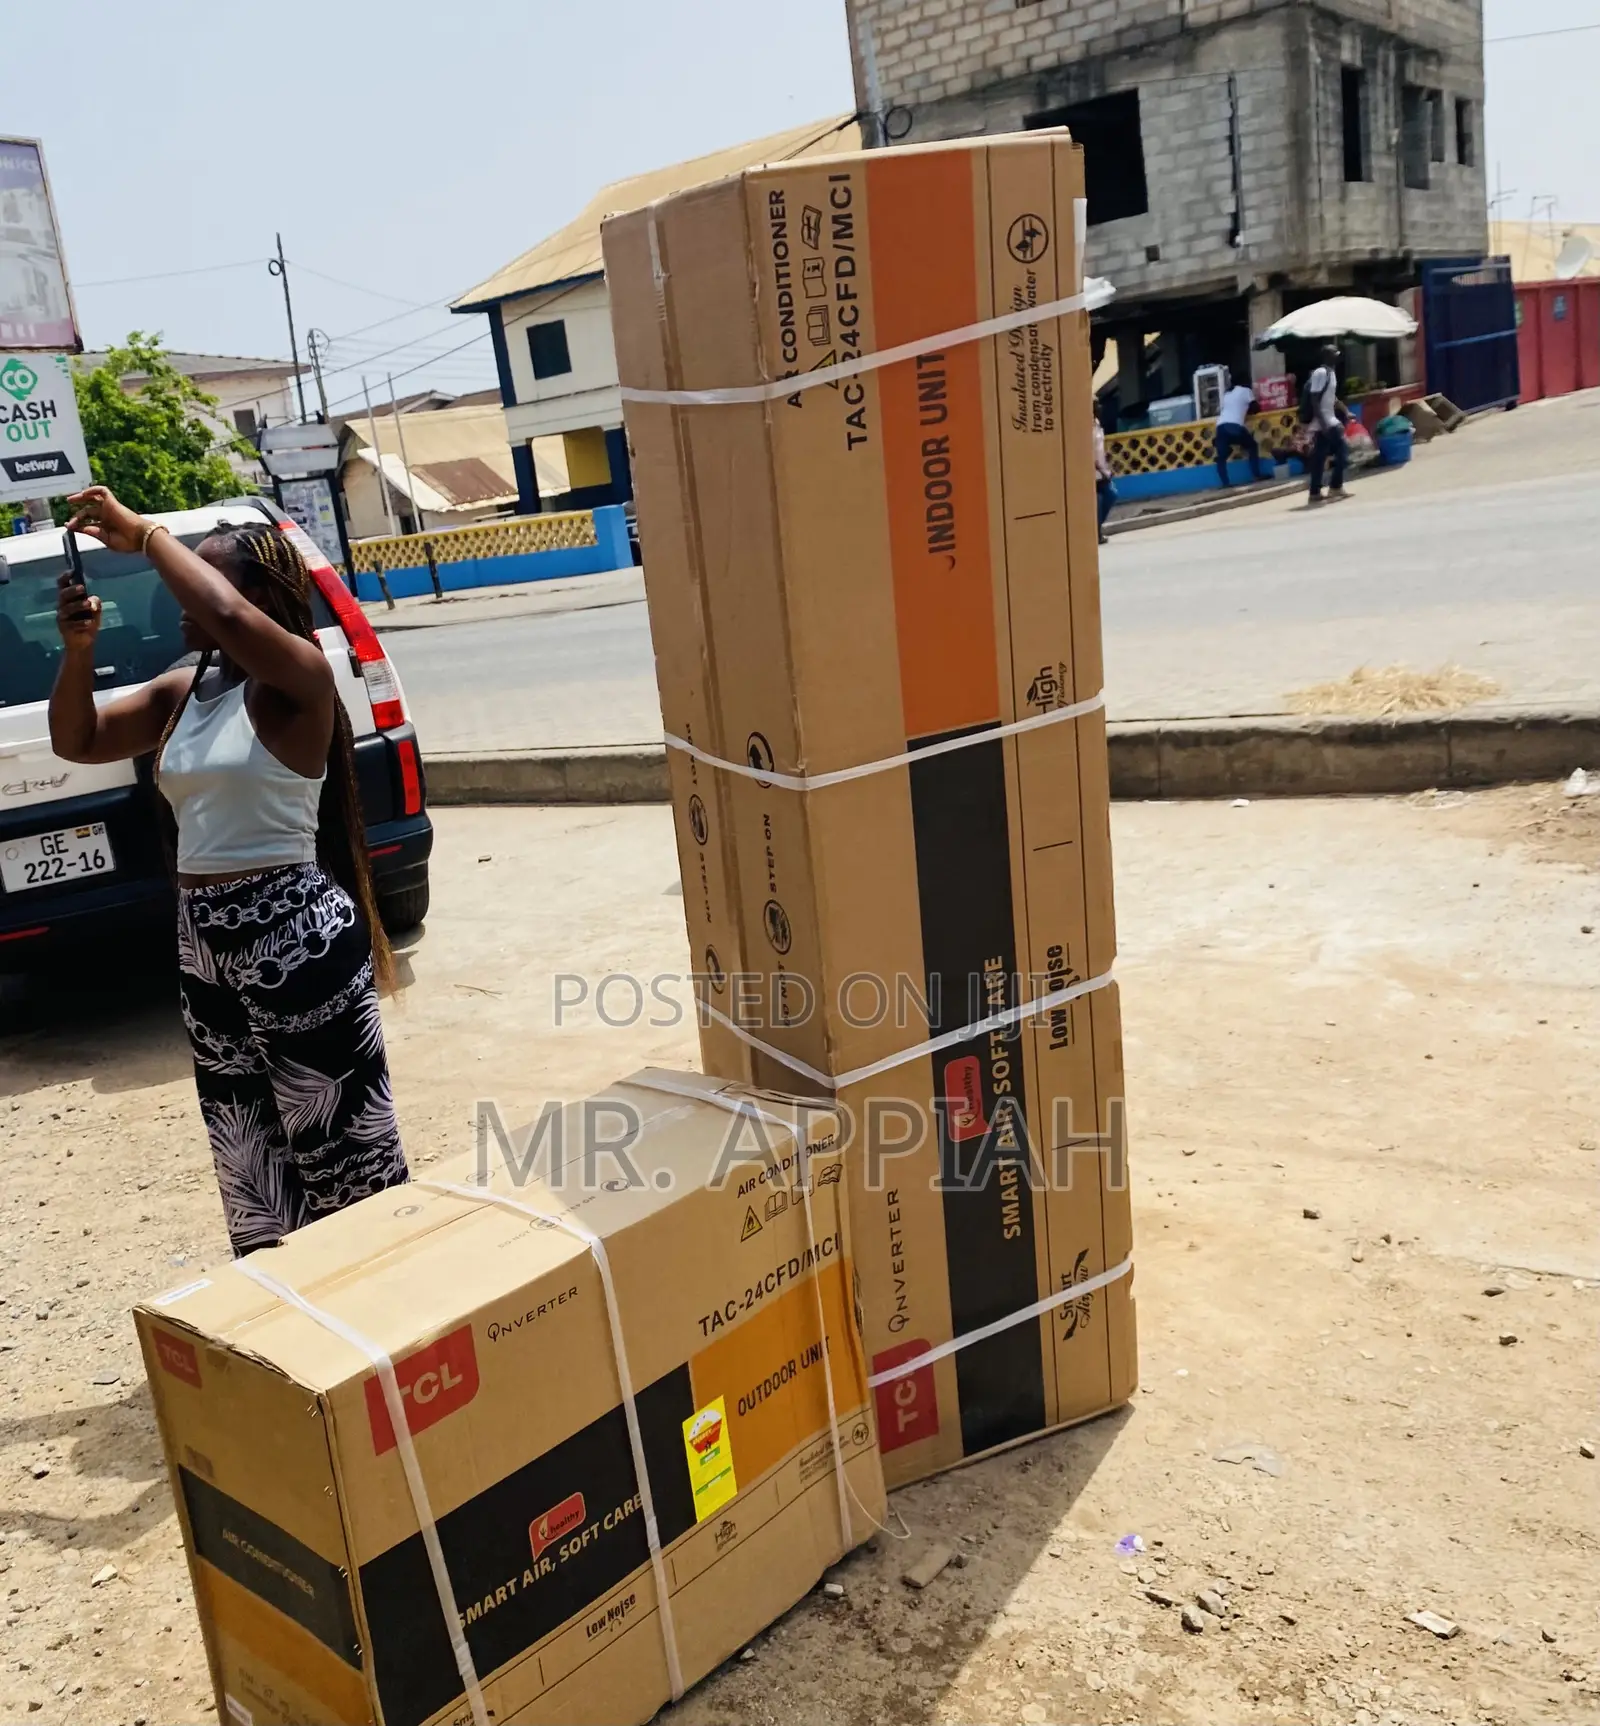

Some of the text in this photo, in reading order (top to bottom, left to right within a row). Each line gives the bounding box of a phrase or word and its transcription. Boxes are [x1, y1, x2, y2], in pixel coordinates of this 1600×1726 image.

[768, 189, 798, 363] CONDITIONER
[1008, 285, 1027, 434] Insulated Dign
[1028, 322, 1042, 398] condensat
[1041, 343, 1055, 432] to electricity
[0, 399, 57, 424] CASH
[6, 420, 52, 443] OUT
[1031, 402, 1043, 434] from
[14, 458, 59, 474] betway
[915, 352, 957, 555] INDOOR UNIT
[40, 832, 69, 857] GE
[763, 813, 772, 841] ON
[24, 848, 106, 884] 222-16
[766, 845, 777, 894] STEP
[983, 955, 1006, 1012] ARE
[1045, 944, 1074, 992] oise
[989, 1030, 1012, 1095] SOFT
[737, 1133, 835, 1199] AIR CONDITONER
[998, 1156, 1021, 1240] SMART
[698, 1232, 841, 1338] TAC-24CFD/MCI
[737, 1358, 797, 1417] OUTDOOR
[894, 1373, 918, 1433] TC
[549, 1509, 580, 1535] healthy
[457, 1491, 643, 1631] SMART AIR, SOFT CARE
